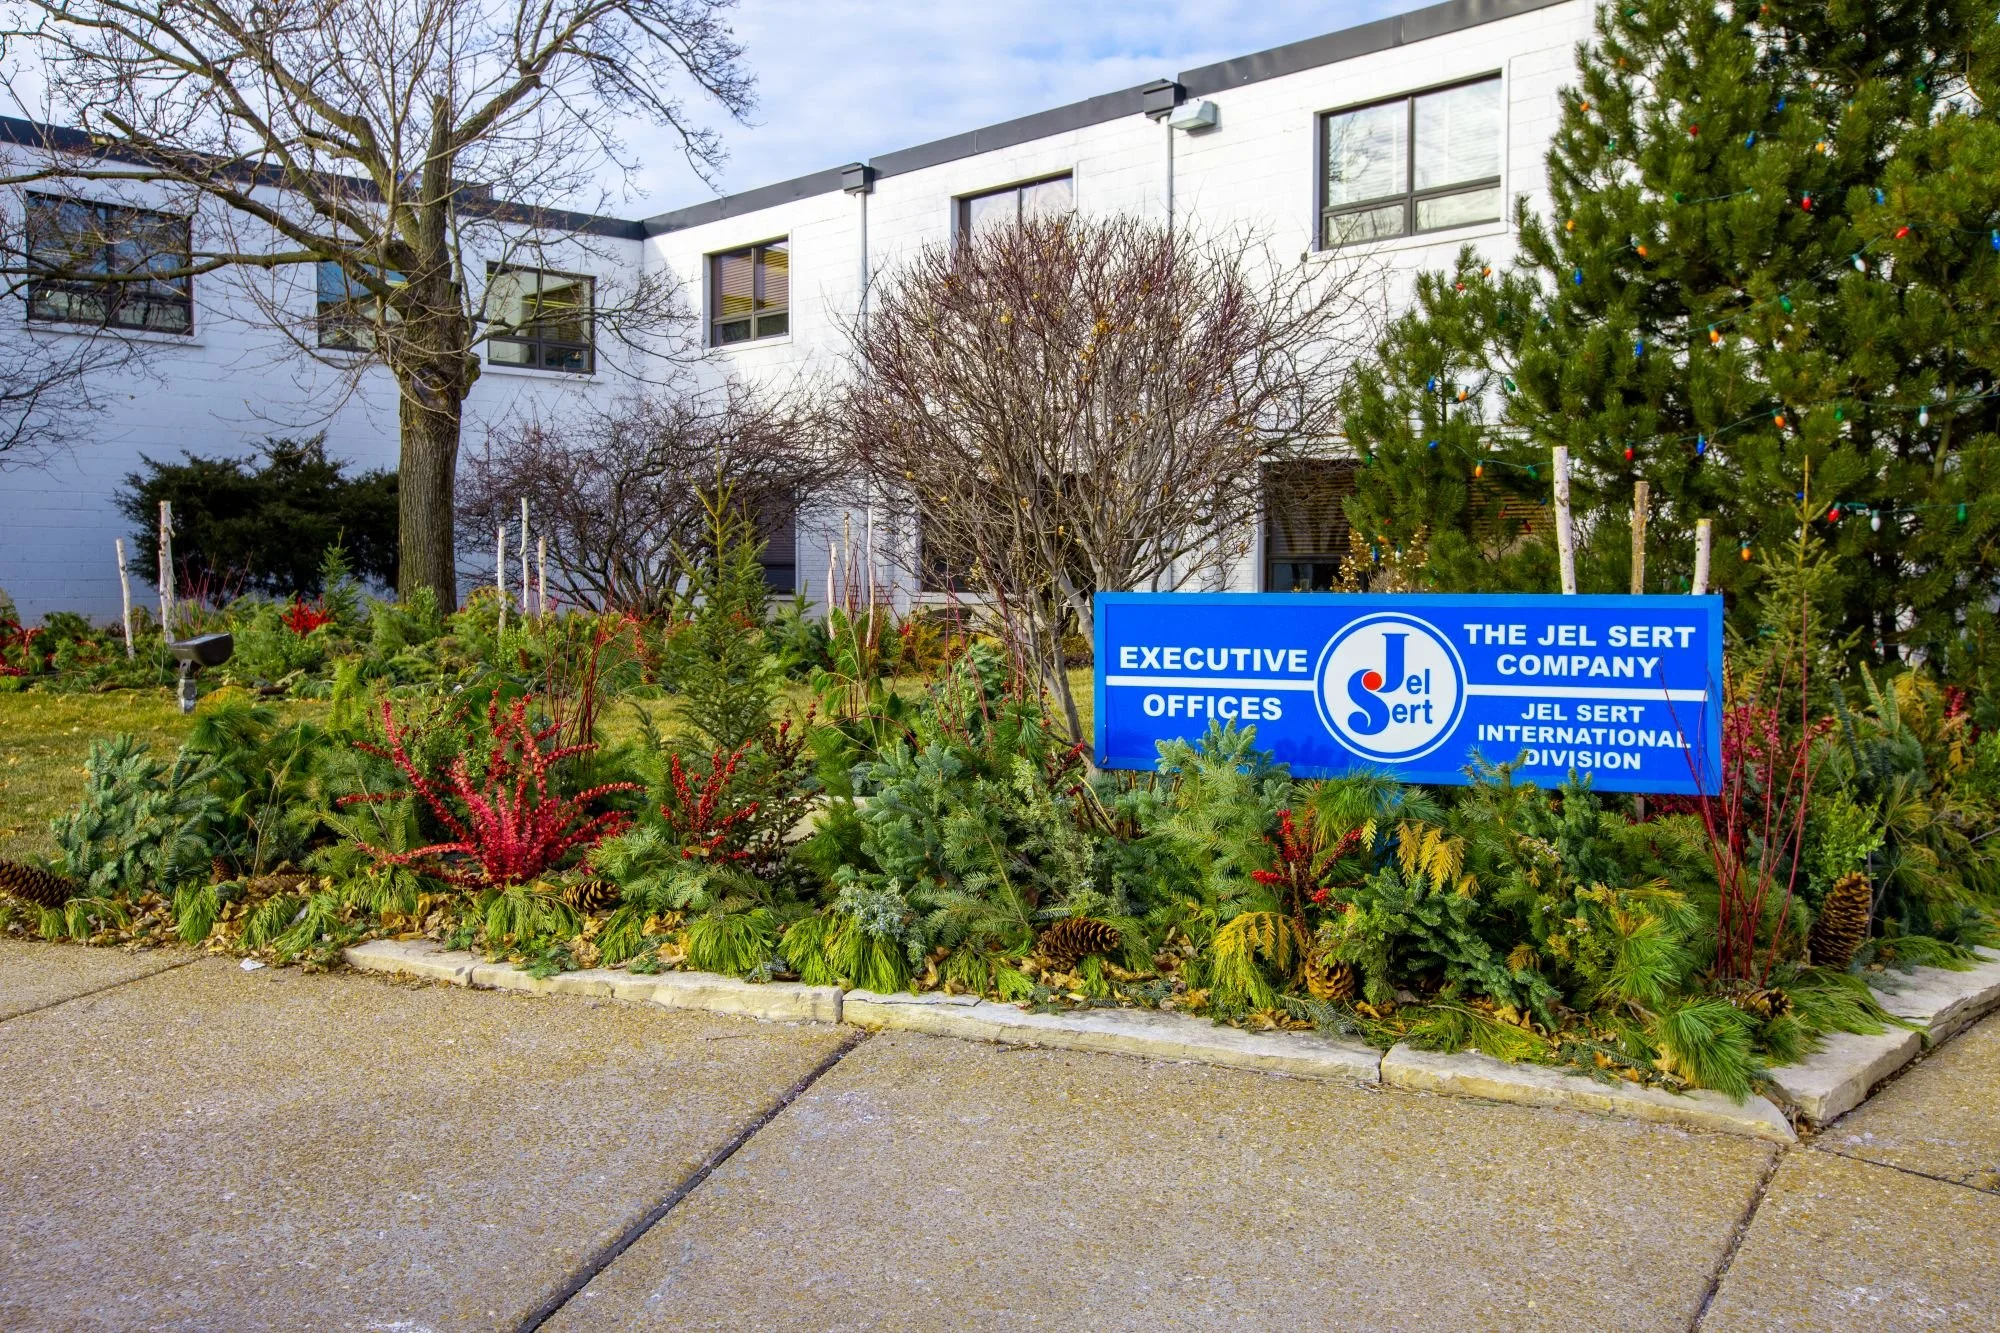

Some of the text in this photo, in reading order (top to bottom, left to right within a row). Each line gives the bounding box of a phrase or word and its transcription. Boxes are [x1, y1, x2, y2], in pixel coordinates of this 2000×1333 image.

[1463, 623, 1697, 649] THE JEL SERT
[1119, 645, 1308, 673] EXECUTIVE
[1376, 633, 1431, 694] Jel
[1496, 653, 1660, 678] COMPANY
[1142, 693, 1283, 721] OFFICES
[1347, 668, 1434, 736] Sert
[1520, 702, 1645, 723] JEL SERT
[1477, 724, 1692, 749] INTERNATIONAL
[1525, 748, 1641, 770] DIVISION
